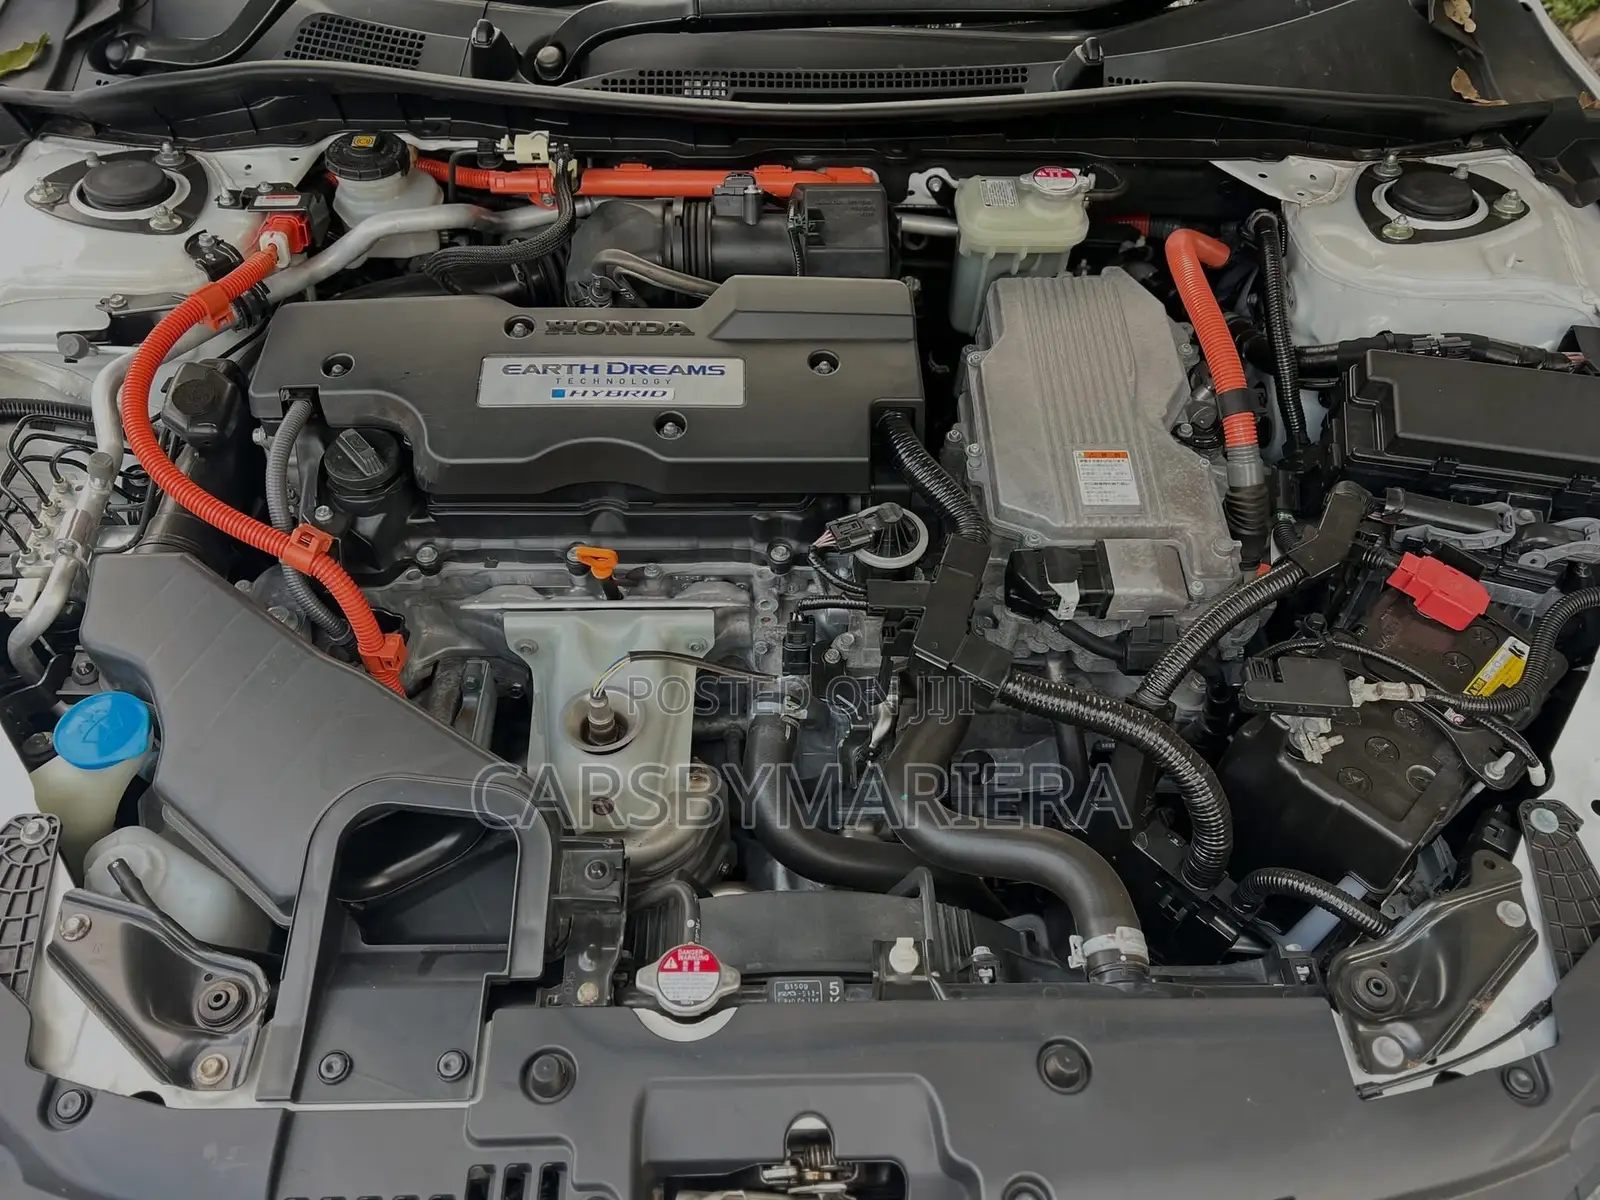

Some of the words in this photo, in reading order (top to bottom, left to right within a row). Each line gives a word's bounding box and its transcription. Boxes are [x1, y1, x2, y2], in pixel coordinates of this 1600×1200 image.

[544, 319, 696, 336] HONDA
[502, 363, 599, 376] EARTH
[606, 361, 726, 376] DREAMS
[555, 377, 673, 386] TECHNOLOGY
[568, 389, 669, 398] HYBRID
